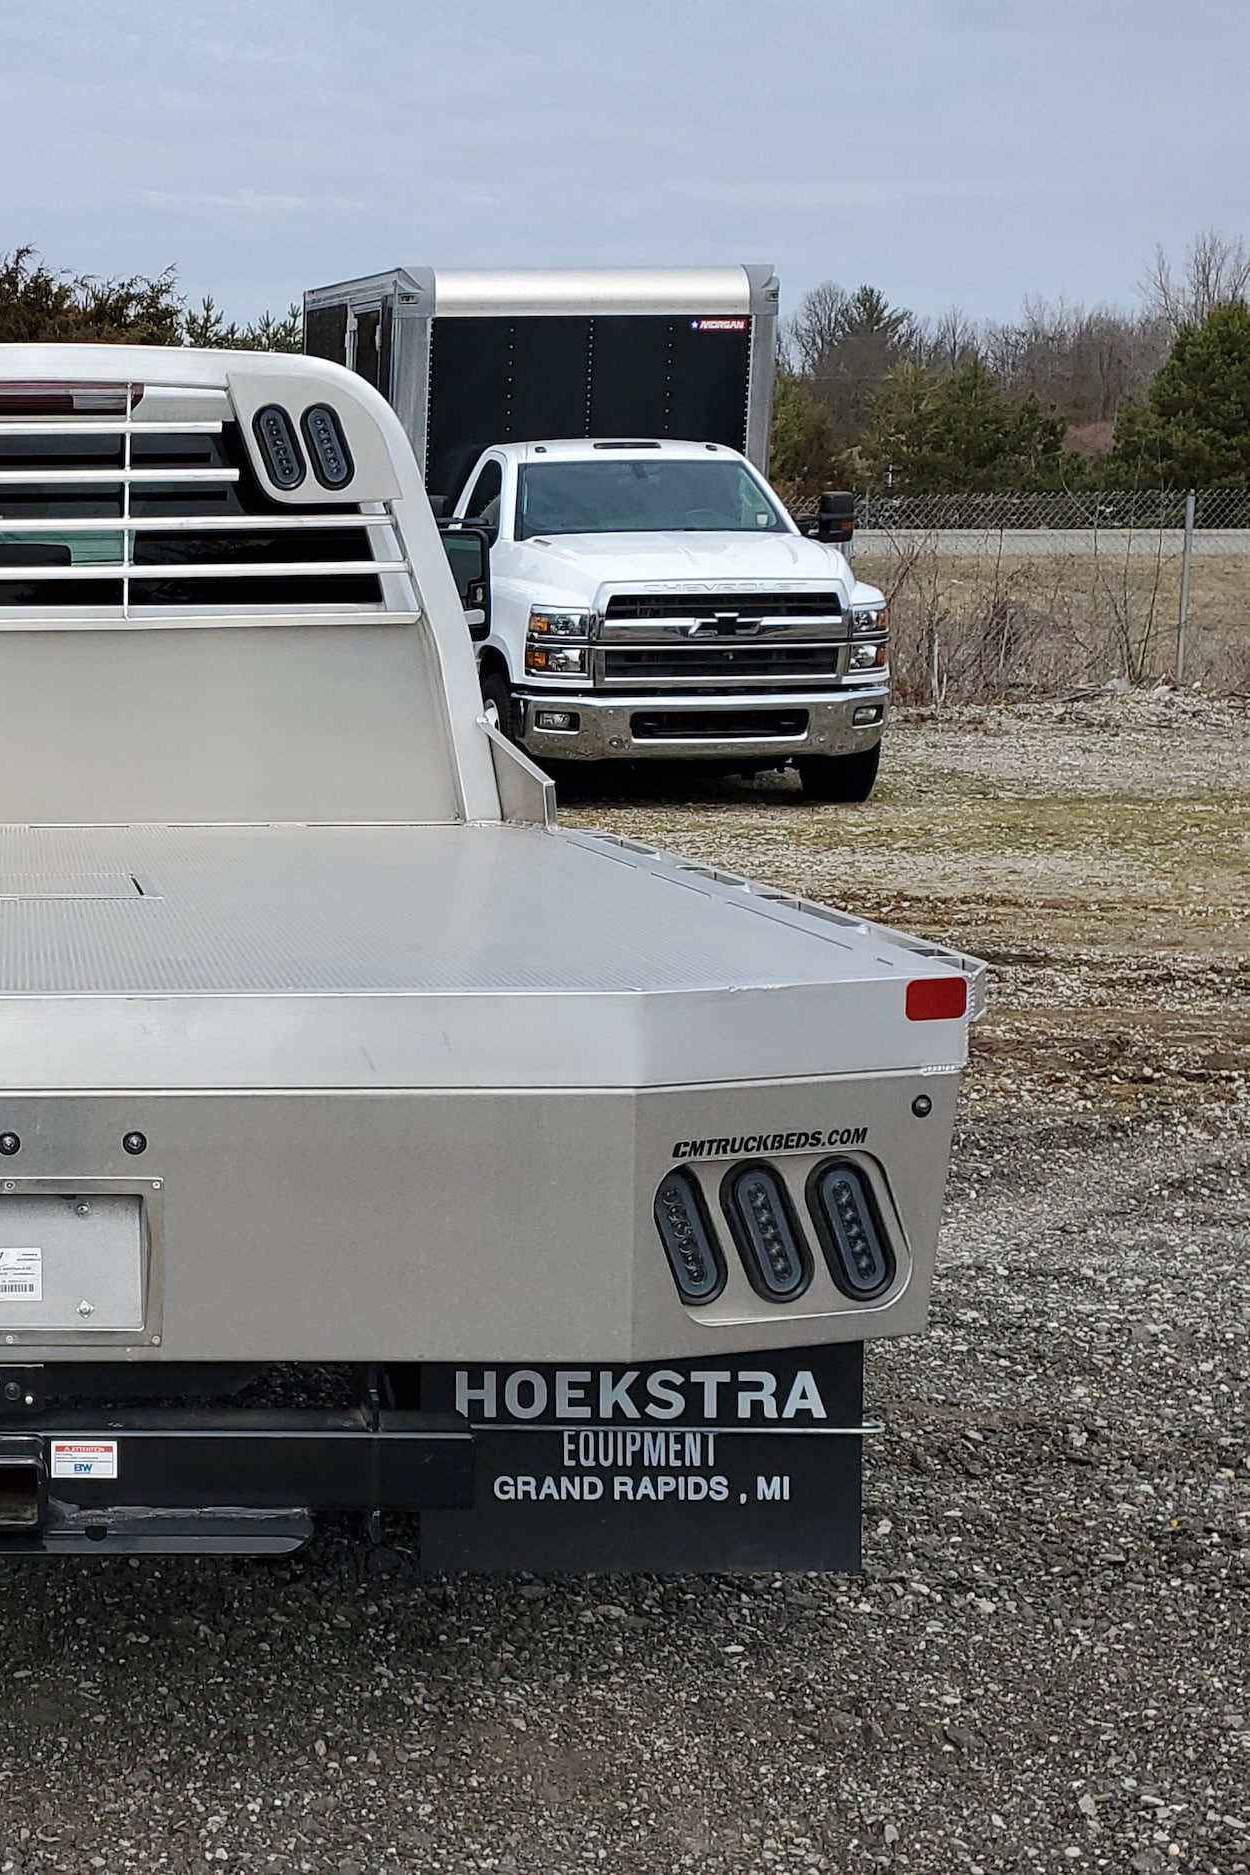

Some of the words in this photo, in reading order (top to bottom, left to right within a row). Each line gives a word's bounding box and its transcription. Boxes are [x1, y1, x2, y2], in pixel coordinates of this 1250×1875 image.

[700, 320, 745, 329] MORGAN
[644, 582, 807, 593] CHEVROLET
[672, 1127, 868, 1157] CMTRUCKBEDS.COM
[455, 1370, 828, 1419] HOEKSTRA
[562, 1430, 716, 1467] EQUIPMENT
[493, 1476, 604, 1501] GRAND
[613, 1476, 729, 1501] RAPIDS
[756, 1476, 790, 1501] MI
